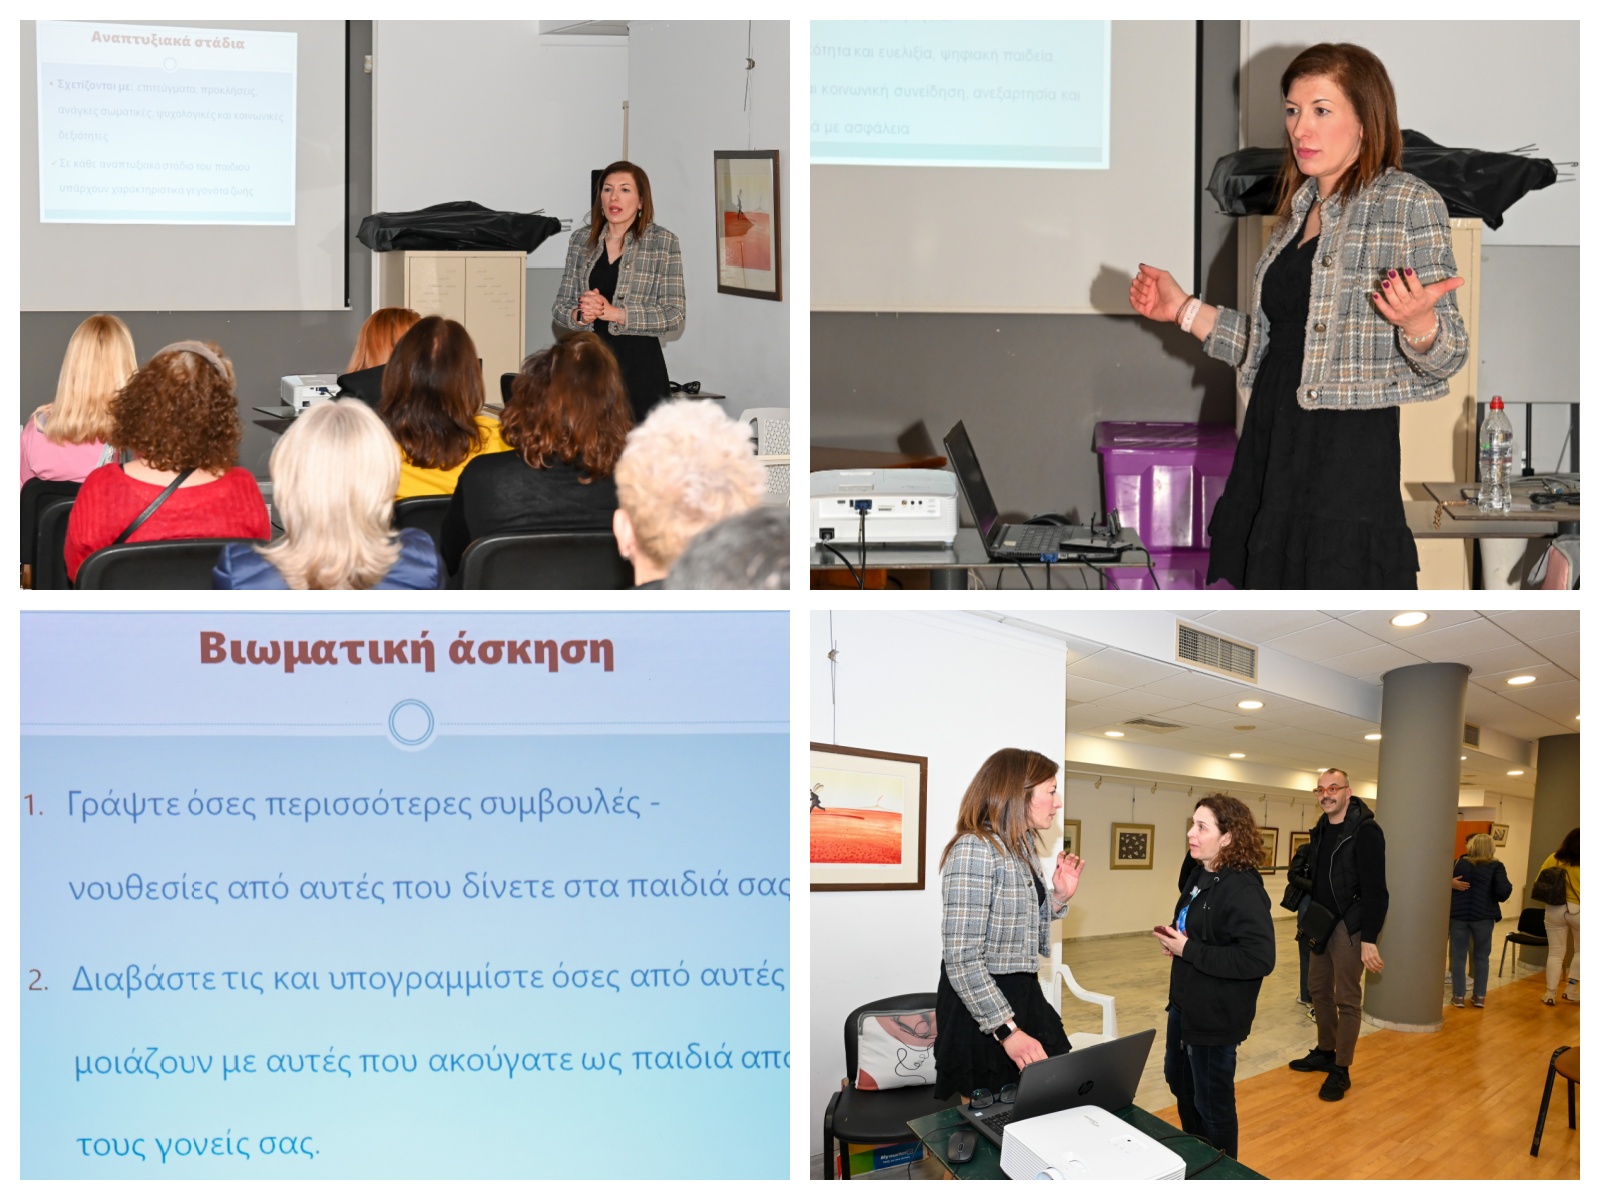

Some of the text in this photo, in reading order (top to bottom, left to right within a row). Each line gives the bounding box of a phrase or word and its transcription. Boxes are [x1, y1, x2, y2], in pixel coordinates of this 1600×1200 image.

[91, 30, 246, 50] Αναπτυξιακά στάδια
[854, 47, 875, 58] και
[878, 46, 936, 62] ευελιξία,
[940, 48, 999, 63] ψηφιακή
[1002, 48, 1057, 64] παιδεία,
[57, 78, 117, 92] Σχετίζονται
[118, 82, 134, 93] με:
[822, 84, 889, 99] κοινωνική
[893, 85, 970, 101] συνείδηση,
[973, 87, 1057, 102] ανεξαρτησία
[1060, 91, 1081, 101] και
[58, 103, 99, 118] ανάγκες
[156, 107, 216, 121] ψυχολογικές
[217, 111, 232, 120] και
[233, 109, 285, 124] κοινωνικές
[58, 129, 109, 143] δεξιότητες
[824, 122, 840, 136] με
[844, 120, 910, 136] ασφάλεια
[59, 157, 250, 172] Σε κάθε αναπτυξιακό στάδιο του παιδιού
[59, 181, 254, 198] υπάρχουν χαρακτηριστικά γεγονότα ζωής
[200, 630, 614, 674] Βιωματική άσκηση
[24, 795, 43, 816] 1.
[68, 788, 180, 824] Γράψτε
[187, 787, 257, 822] όσες
[265, 788, 473, 824] περισσότερες
[480, 786, 641, 824] συμβουλές
[69, 868, 790, 906] νουθεσίες από αυτές που δίνετε στα παιδιά σας
[29, 958, 786, 1000] 2. Διαβάστε τις και υπογραμμίστε όσες από αυτές
[75, 1046, 214, 1083] μοιάζουν
[223, 1054, 257, 1082] με
[266, 1045, 352, 1078] αυτές
[360, 1052, 418, 1076] που
[428, 1044, 574, 1079] ακούγατε
[581, 1051, 623, 1077] ως
[632, 1041, 734, 1071] παιδιά
[76, 1127, 322, 1166] τους γονείς σας.
